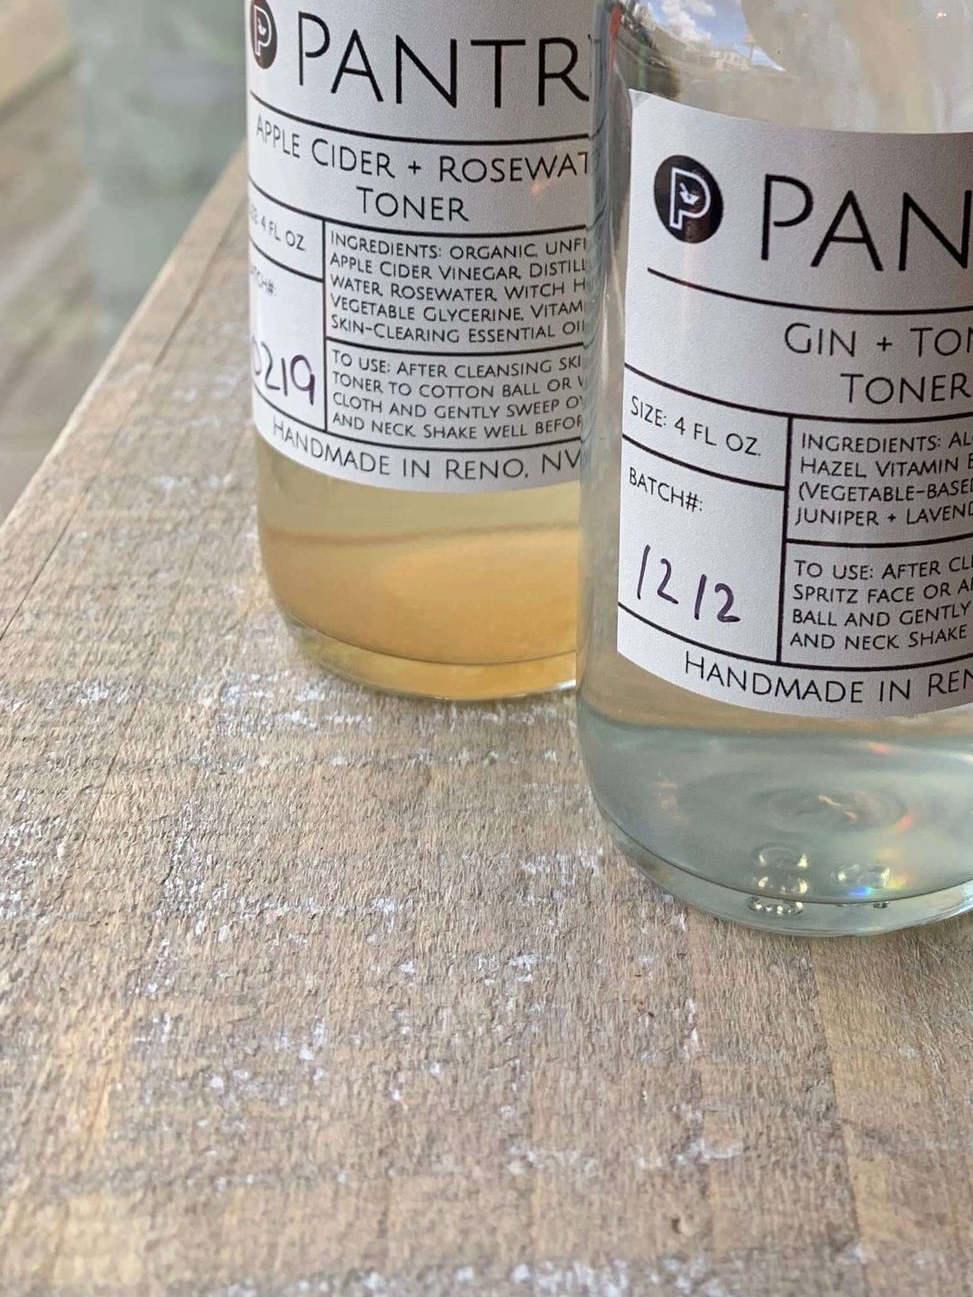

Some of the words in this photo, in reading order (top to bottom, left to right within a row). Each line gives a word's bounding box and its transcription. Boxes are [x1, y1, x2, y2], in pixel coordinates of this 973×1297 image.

[298, 11, 590, 109] PANTR
[256, 114, 301, 159] APPLE
[311, 138, 396, 179] CIDER
[408, 161, 421, 175] +
[356, 186, 470, 222] TONER
[330, 230, 442, 259] INGREDIENTS:
[330, 252, 372, 274] APPLE
[380, 261, 432, 279] CIDER
[330, 292, 415, 321] VEGETABLE
[331, 314, 460, 343] SKIN-CLEARING
[468, 325, 556, 343] ESSENTIAL
[784, 323, 856, 358] GIN
[877, 336, 893, 352] +
[332, 349, 352, 367] TO
[359, 357, 390, 373] USE:
[396, 361, 448, 378] AFTER
[454, 360, 552, 379] CLEANSING
[332, 371, 384, 394] TONER
[389, 381, 412, 396] TO
[419, 384, 494, 399] COTTON
[502, 383, 541, 398] BALL
[547, 377, 572, 392] OR
[840, 373, 972, 405] TONER
[333, 392, 382, 414] CLOTH
[389, 402, 427, 418] AND
[434, 405, 500, 419] GENTLY
[506, 399, 560, 418] SWEEP
[333, 412, 365, 431] AND
[423, 424, 478, 439] SHAKE
[484, 423, 528, 439] WELL
[631, 395, 667, 428] SIZE:
[674, 417, 686, 435] 4
[694, 423, 717, 446] FL
[272, 414, 391, 476] HANDMADE
[402, 458, 431, 479] IN
[802, 432, 941, 453] INGREDIENTS:
[875, 456, 959, 477] VITAMIN
[629, 467, 703, 513] BATCH#:
[795, 506, 879, 527] JUNIPER
[887, 513, 897, 523] +
[794, 559, 823, 578] TO
[833, 564, 874, 580] USE:
[881, 560, 941, 580] AFTER
[793, 583, 858, 604] SPRITZ
[867, 586, 915, 604] FACE
[923, 582, 951, 601] OR
[792, 608, 837, 627] BALL
[844, 612, 890, 627] AND
[899, 600, 971, 625] GENTLY
[790, 632, 835, 650] AND
[908, 624, 967, 648] SHAKE
[684, 651, 863, 703] HANDMADE
[879, 678, 911, 702] IN
